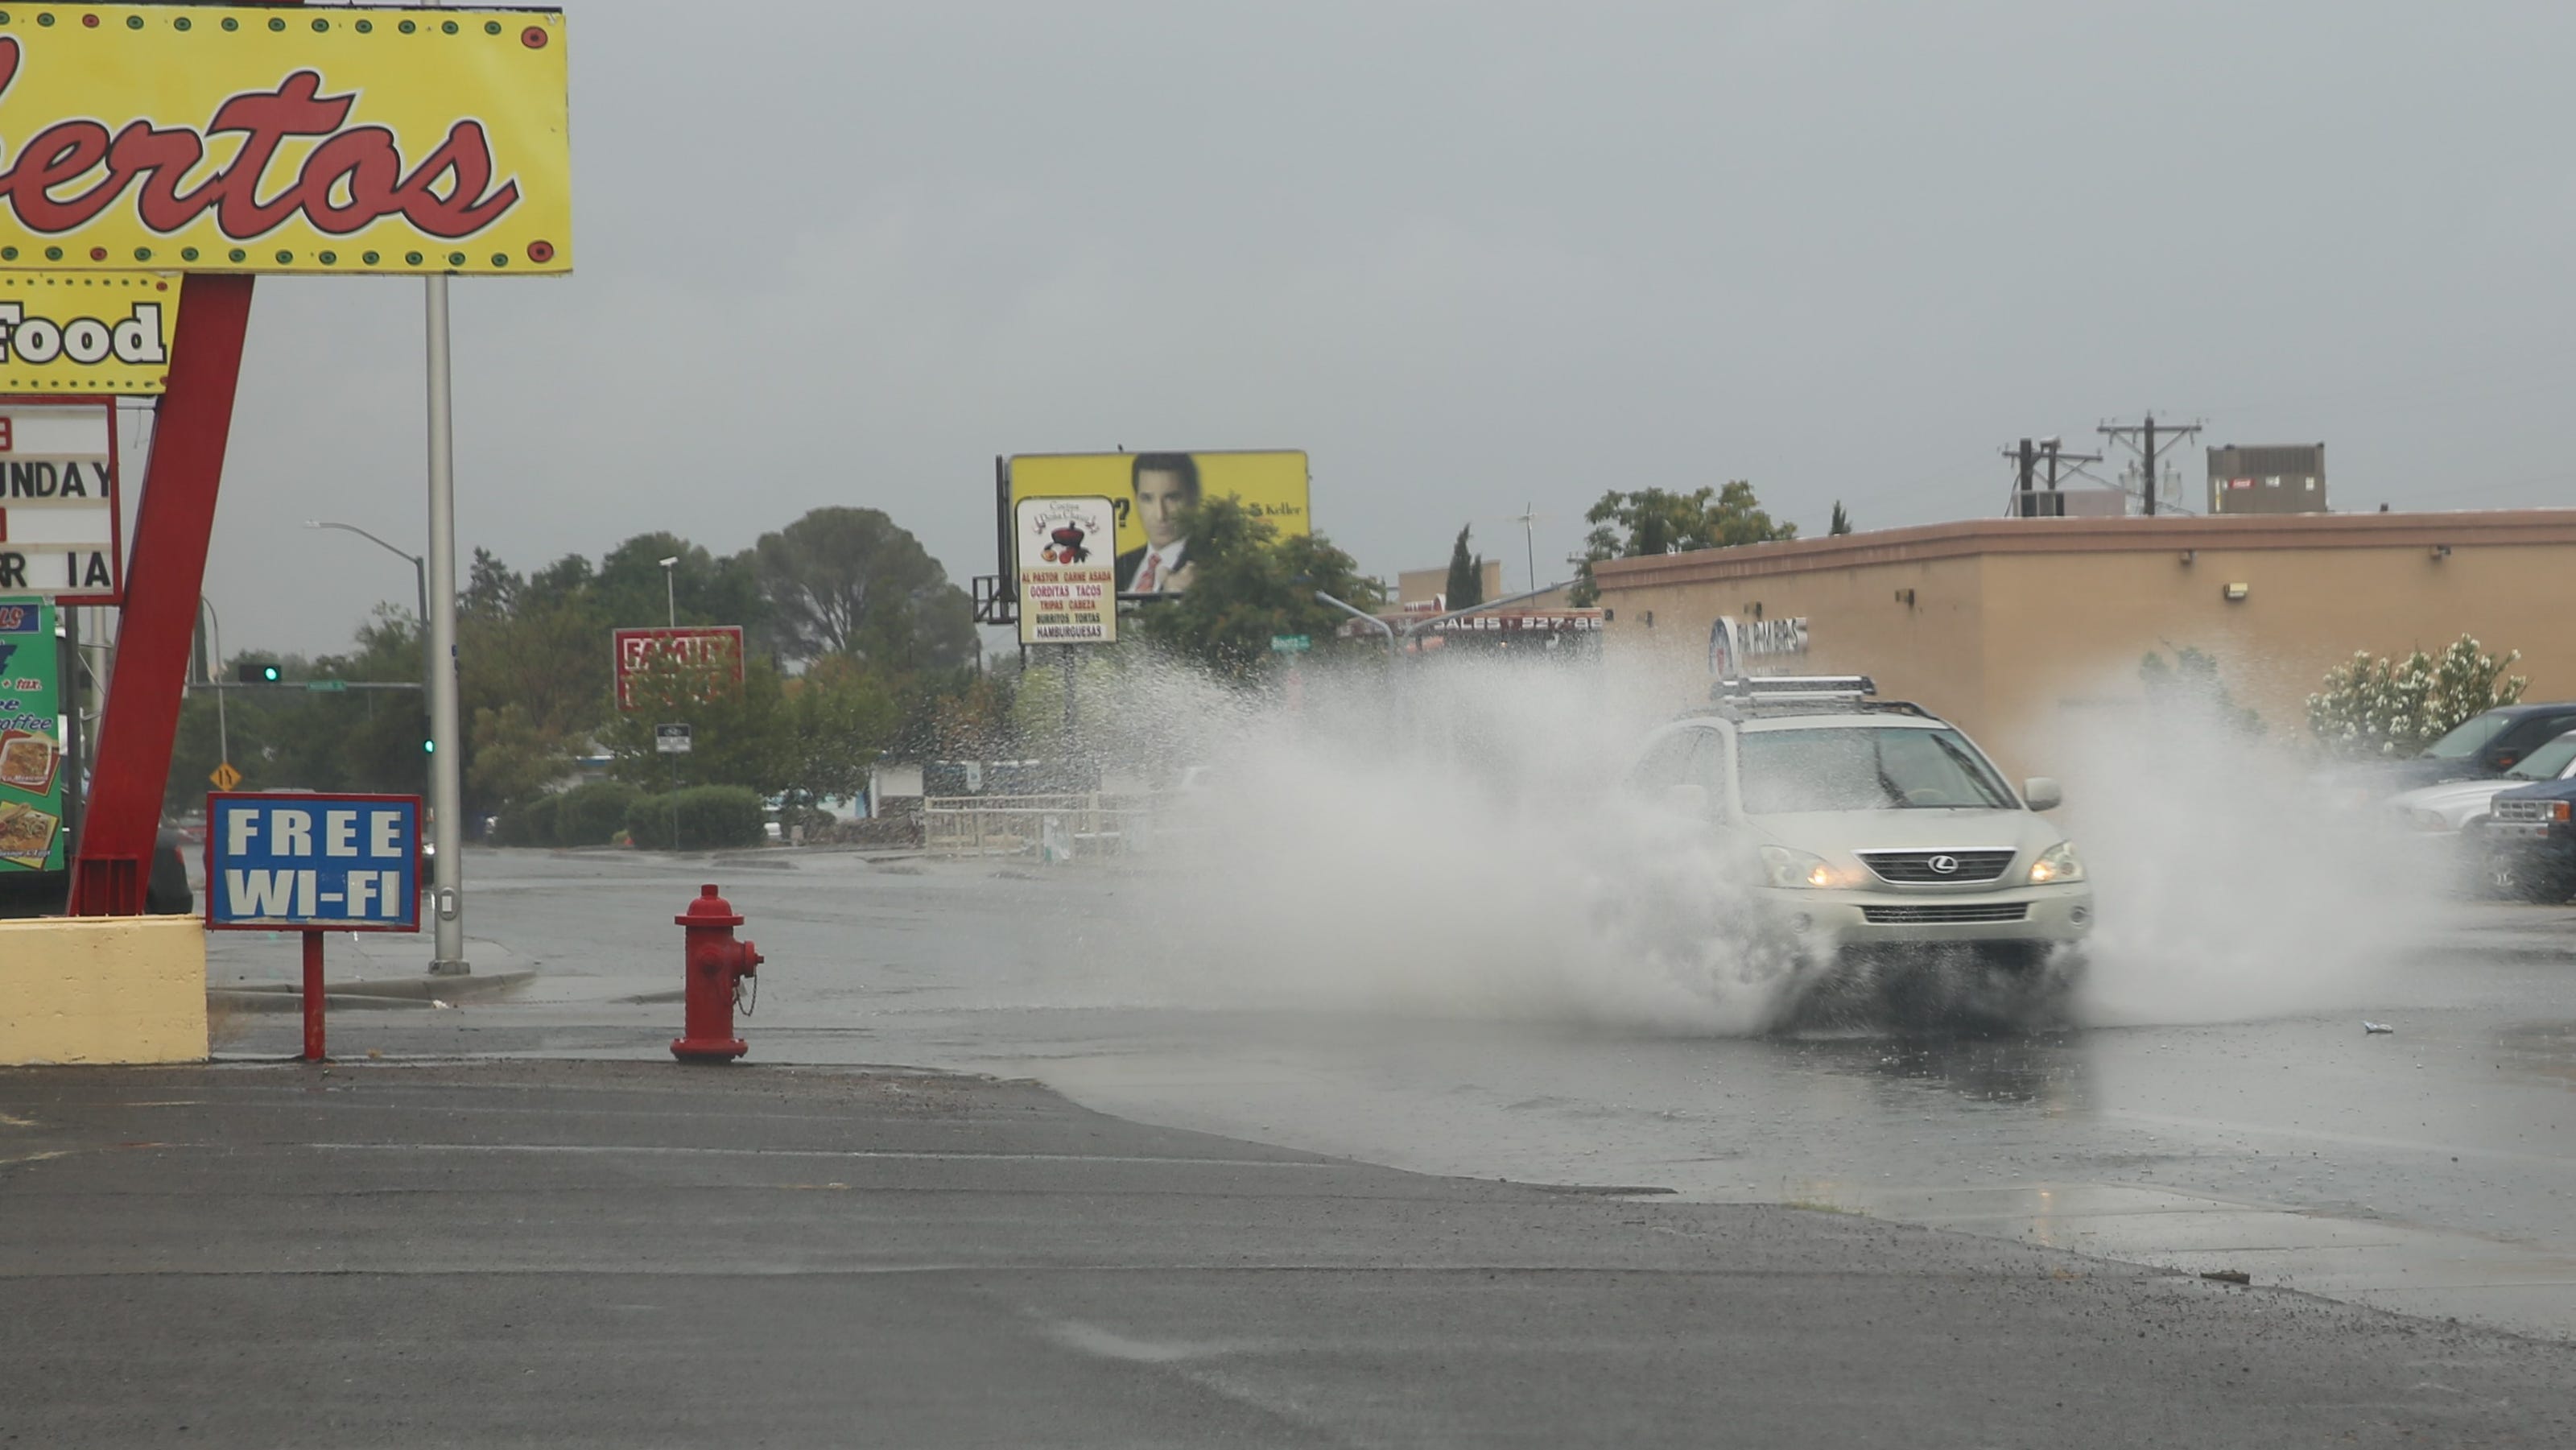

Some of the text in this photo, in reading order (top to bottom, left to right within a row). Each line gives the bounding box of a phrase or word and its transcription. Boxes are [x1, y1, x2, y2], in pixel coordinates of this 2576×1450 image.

[1022, 570, 1112, 582] AL PASTOR CARNE ASADA
[1030, 585, 1101, 597] GORDITAS TACOS
[1040, 600, 1096, 609] TRIPAS CABEZA
[1036, 613, 1100, 624] BURRITOS TORTAS
[1434, 617, 1501, 630] SALES
[1036, 626, 1101, 638] HAMBURGUESAS
[1736, 618, 1802, 654] FARMERS
[16, 677, 43, 691] tax.
[228, 808, 402, 857] FREE
[225, 869, 400, 917] WI-FI
